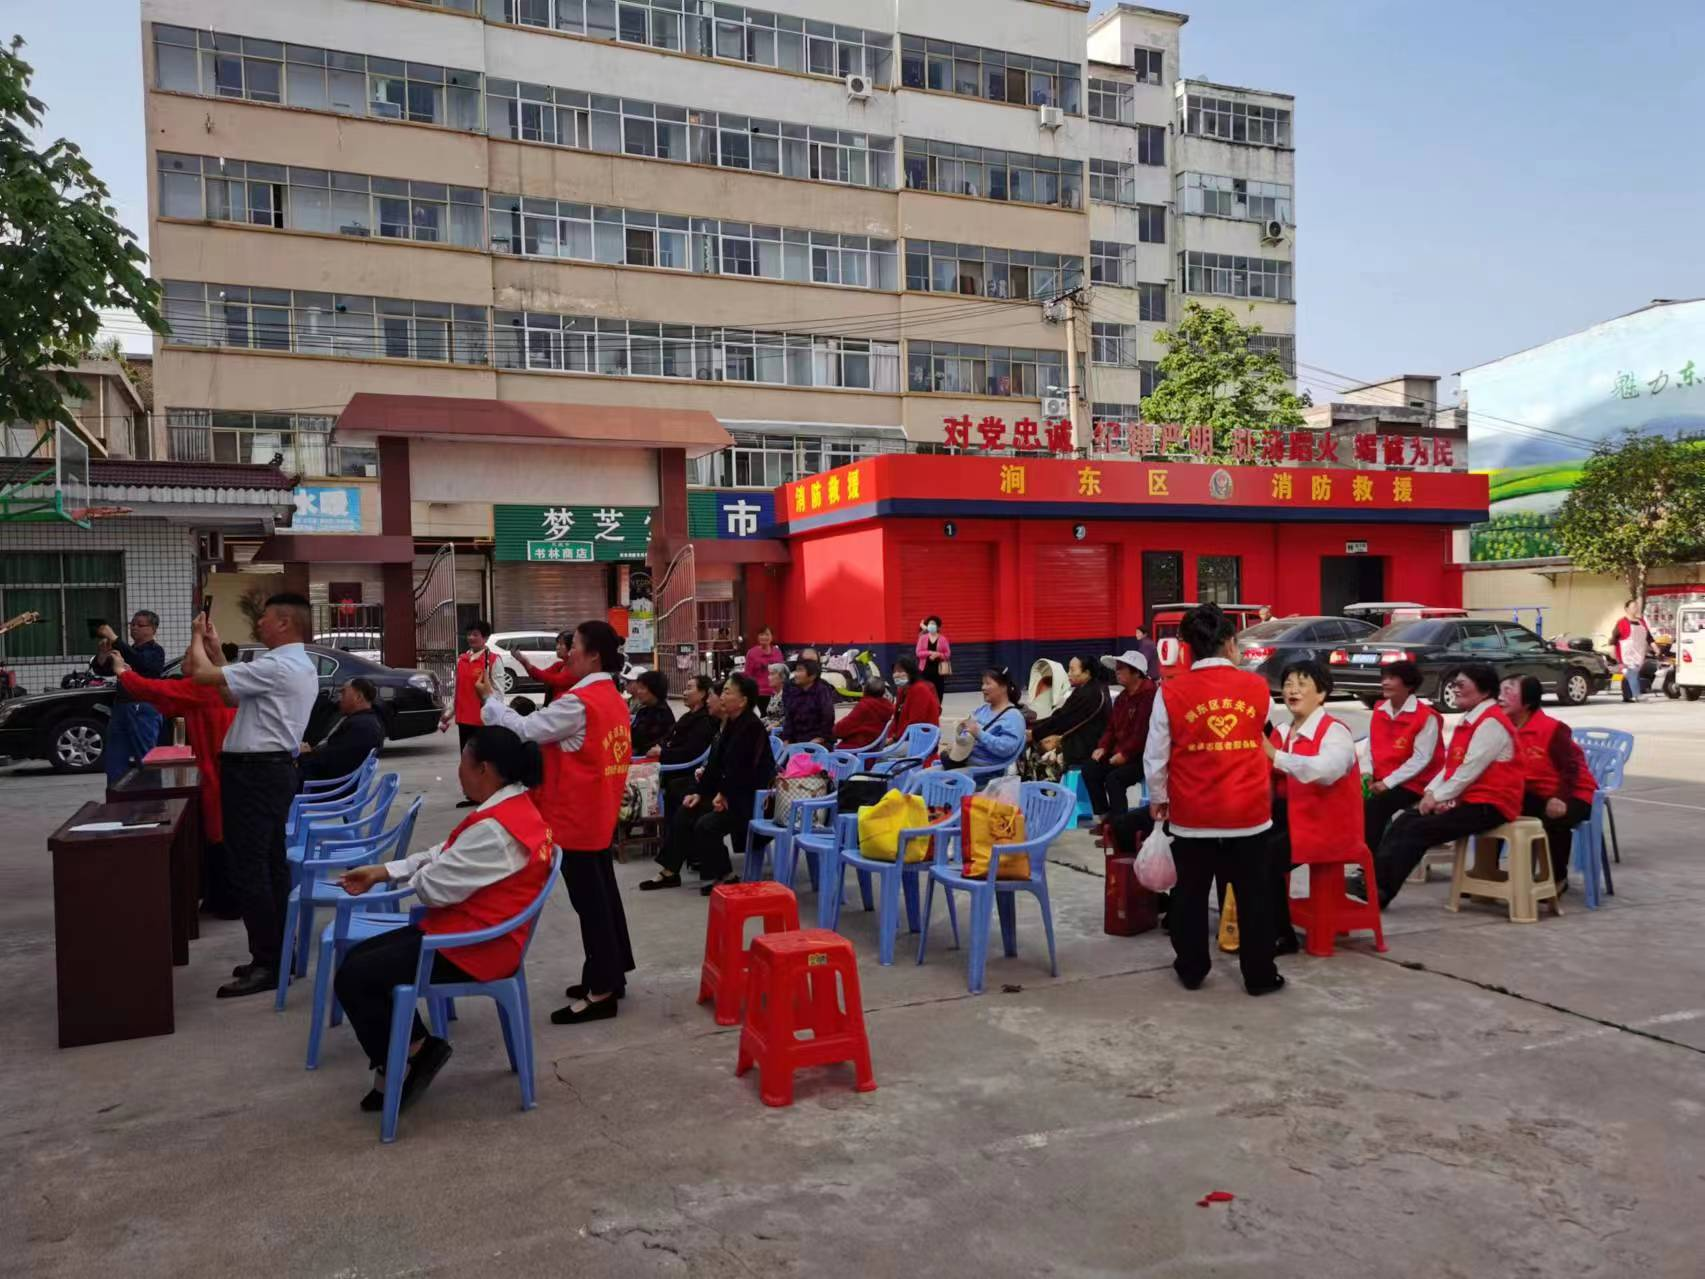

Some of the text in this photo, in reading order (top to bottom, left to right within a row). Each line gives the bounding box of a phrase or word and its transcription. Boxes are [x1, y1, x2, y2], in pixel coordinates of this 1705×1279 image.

[943, 414, 1076, 451] 对党忠诚
[795, 469, 860, 513] 消防救援
[1000, 464, 1413, 502] 涧东区 消防救援
[541, 507, 651, 541] 梦芝
[723, 499, 761, 537] 市
[945, 525, 953, 535] 1
[534, 547, 587, 560] 书林商店
